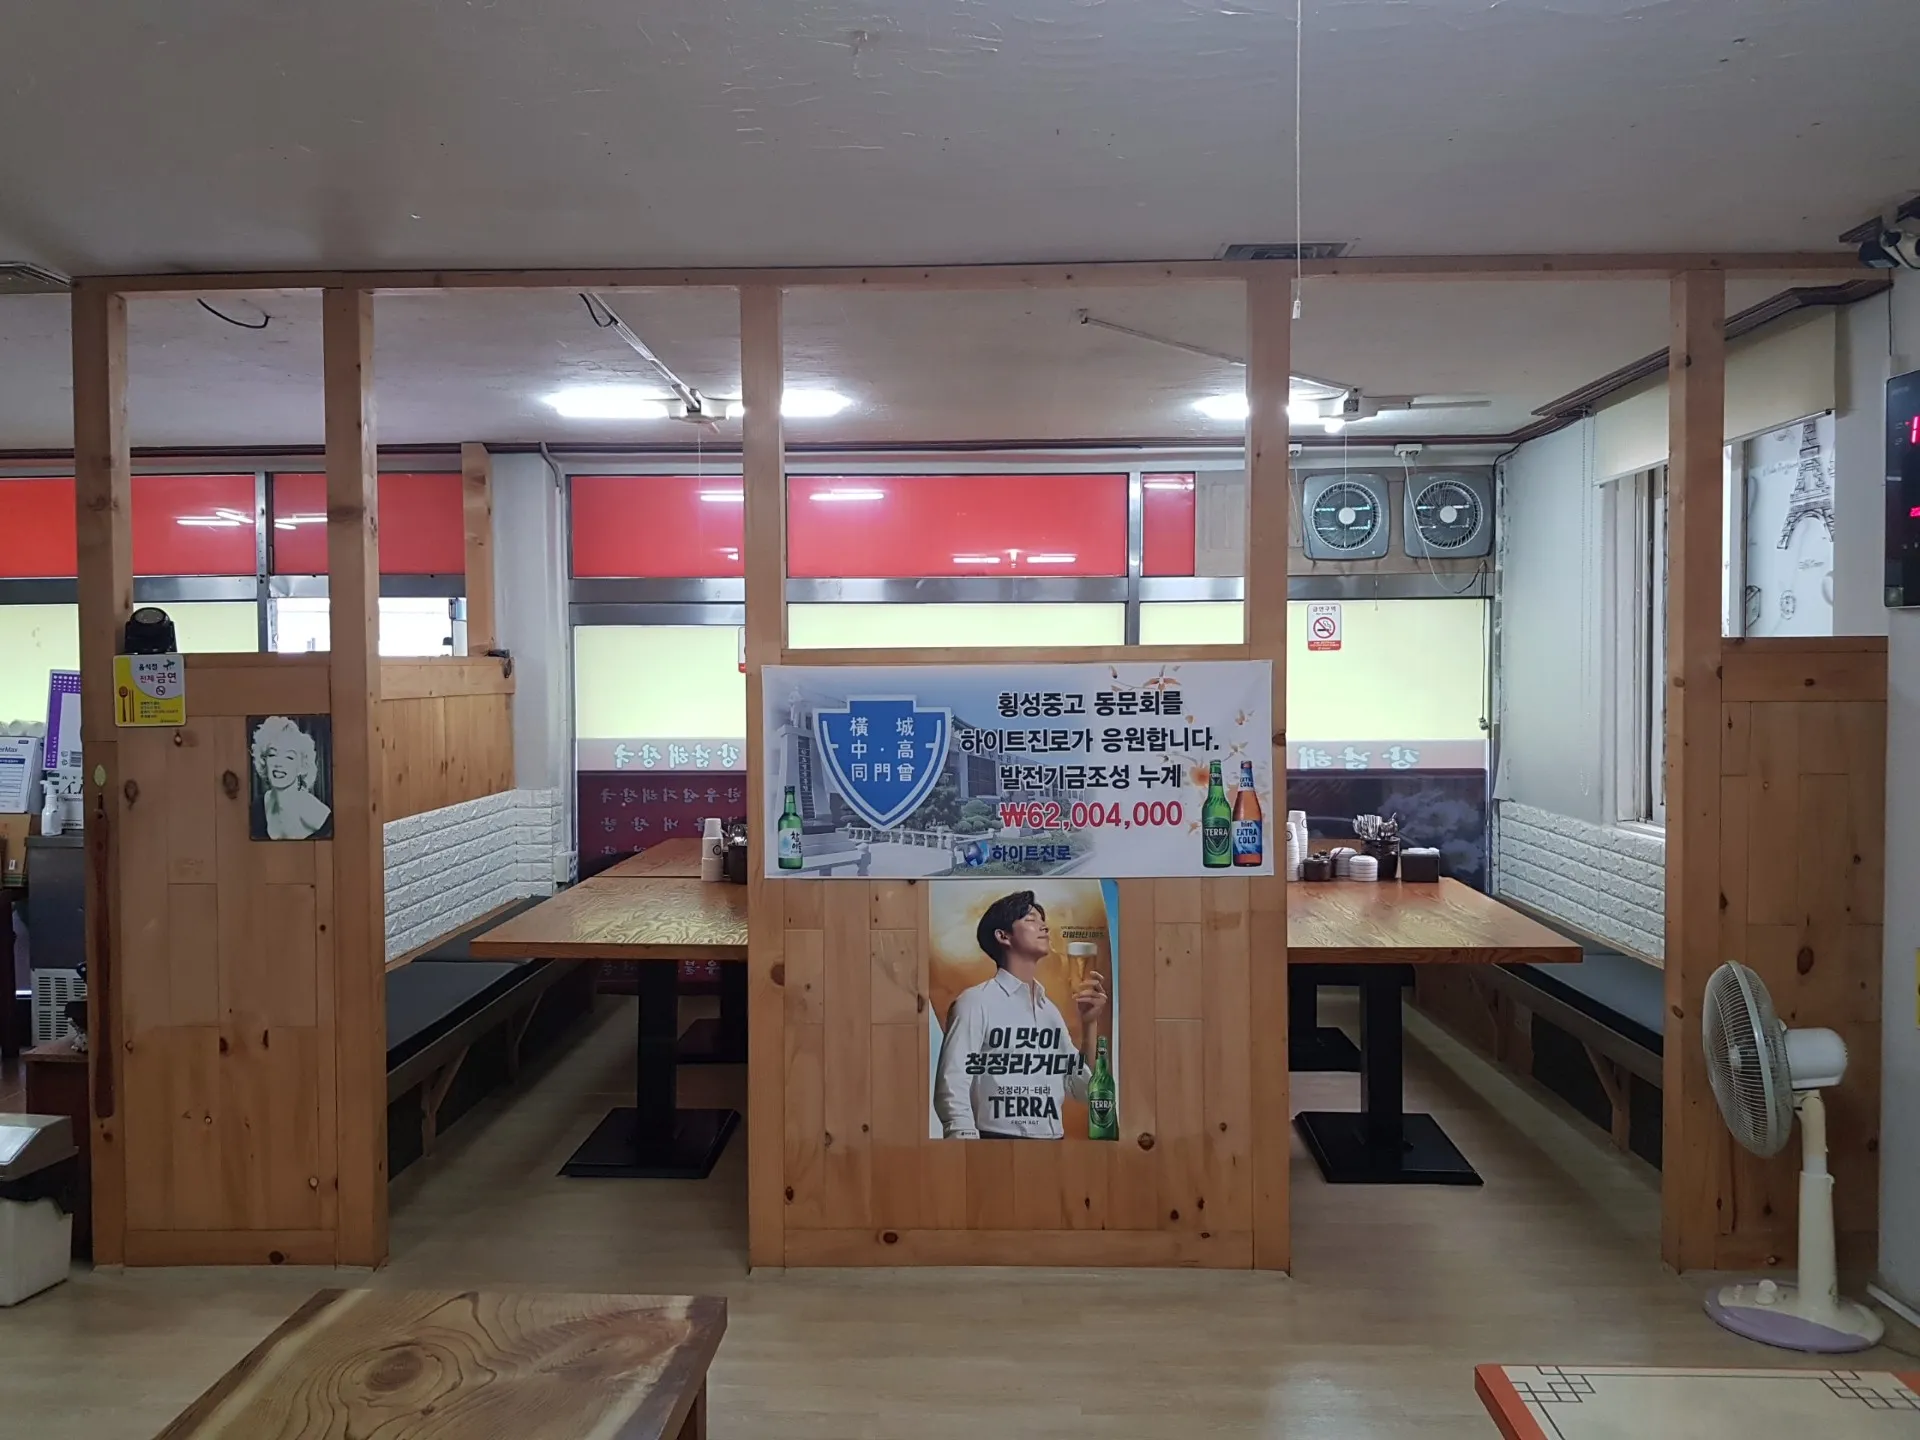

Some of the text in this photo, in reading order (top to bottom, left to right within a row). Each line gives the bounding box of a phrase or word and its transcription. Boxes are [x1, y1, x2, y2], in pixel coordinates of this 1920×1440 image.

[156, 672, 177, 684] 금연
[998, 690, 1183, 717] 횡성중고 동문회를
[960, 727, 1219, 754] 하이트진로가 응원합니다.
[1000, 764, 1181, 790] 발전기금조성 누계
[1205, 827, 1228, 837] TERRA
[1236, 828, 1258, 836] EXTRA
[1238, 836, 1257, 844] COLD
[992, 845, 1072, 862] 하이트진로
[988, 1027, 1062, 1050] 이 맛이
[964, 1053, 1085, 1076] 청정라거다!
[988, 1096, 1059, 1120] TERRA
[1091, 1100, 1113, 1109] TERRA
